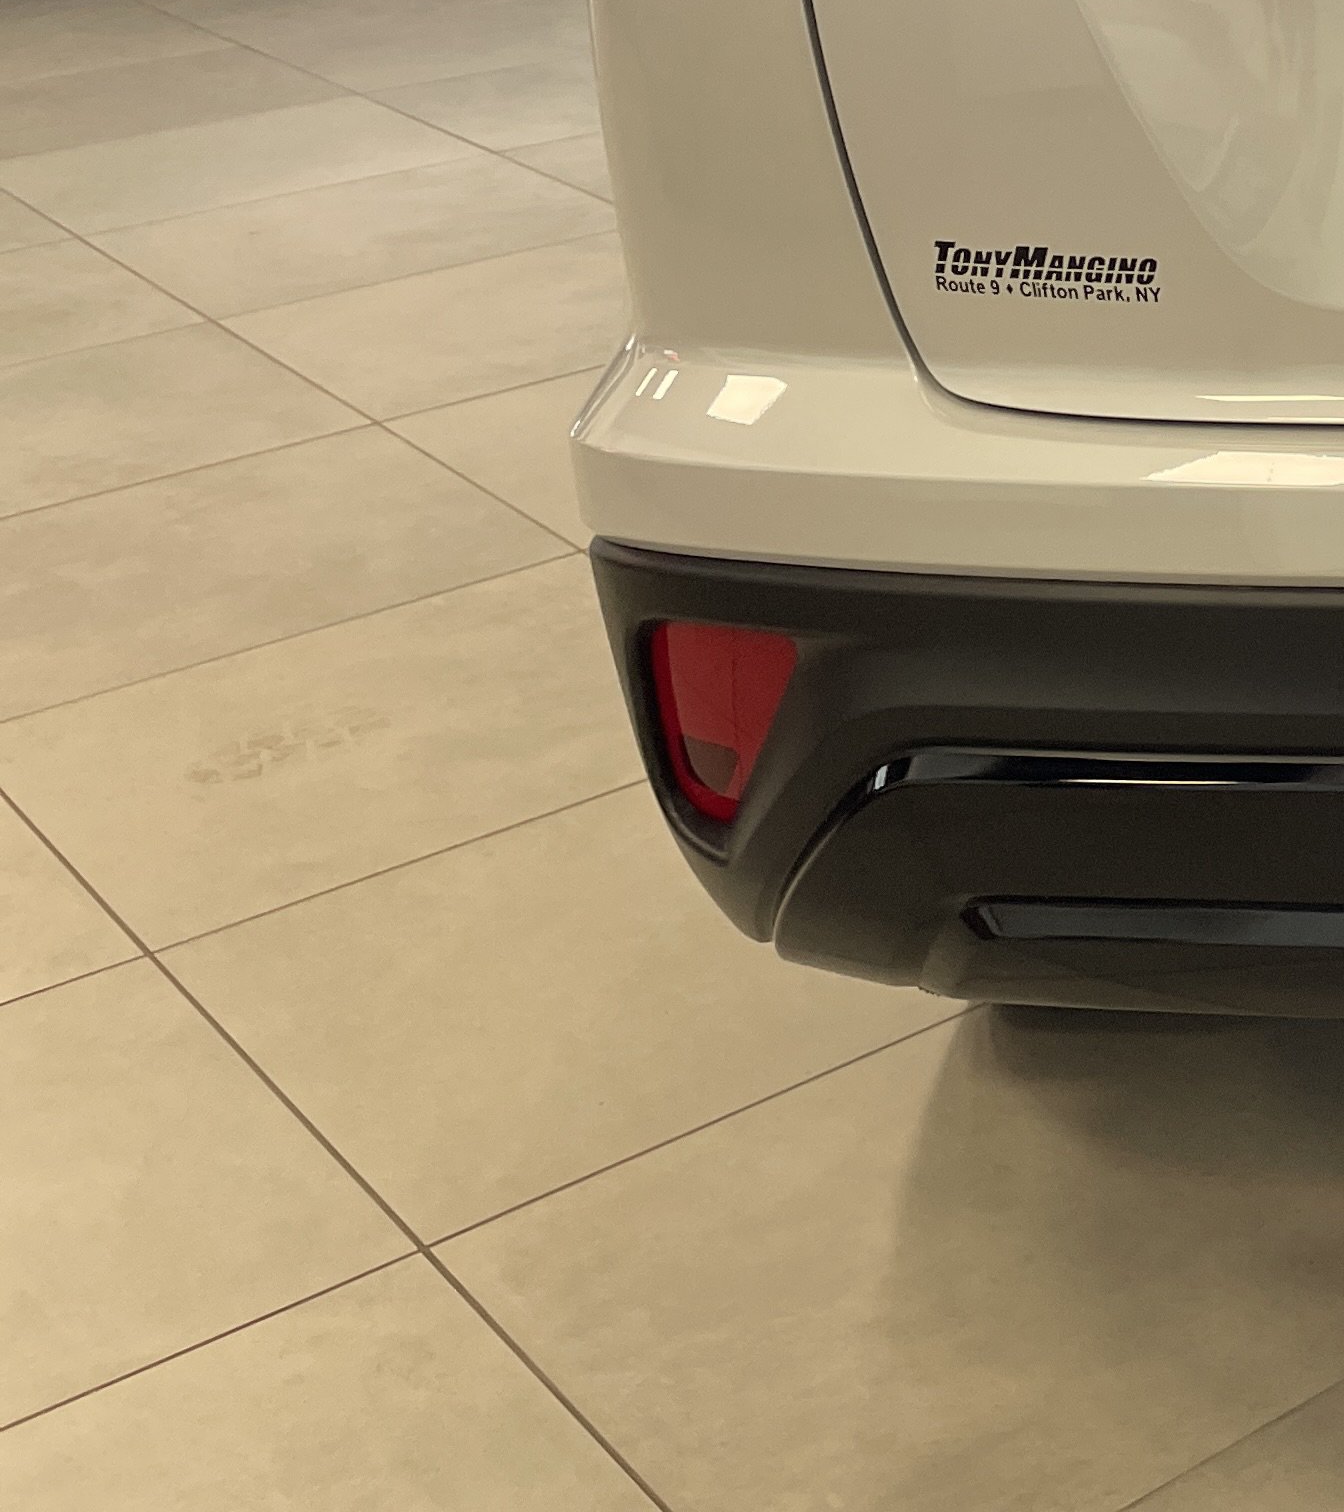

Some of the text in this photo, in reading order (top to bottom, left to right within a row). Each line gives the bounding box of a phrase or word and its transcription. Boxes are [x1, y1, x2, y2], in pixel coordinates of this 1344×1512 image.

[936, 276, 1161, 303] Route 9 Clifton Park, NY
